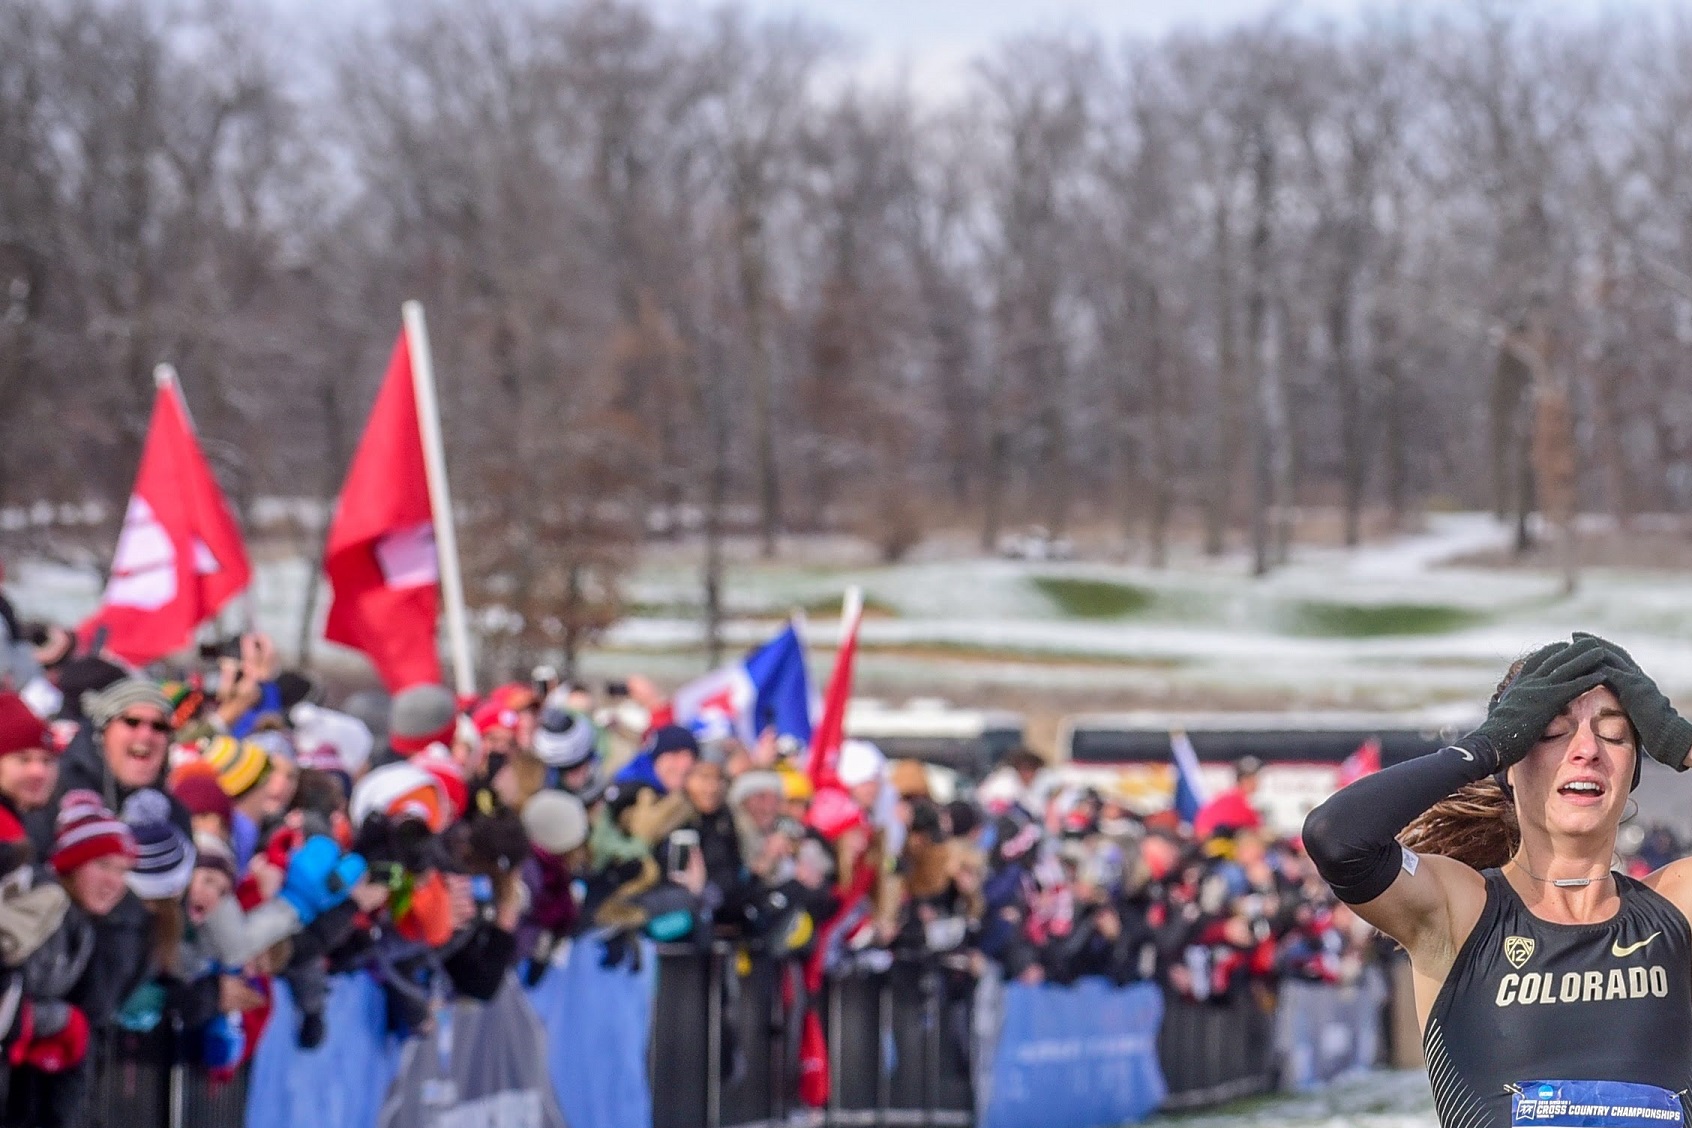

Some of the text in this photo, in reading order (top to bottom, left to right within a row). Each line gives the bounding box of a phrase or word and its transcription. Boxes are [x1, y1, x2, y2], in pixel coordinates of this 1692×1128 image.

[1507, 937, 1533, 952] PAC
[1511, 950, 1526, 962] 12
[1495, 965, 1668, 1007] COLORADO
[1536, 1104, 1567, 1115] CROSS
[1568, 1105, 1610, 1117] COUNTRY
[1611, 1106, 1680, 1120] CHAMPIONSHIPS
